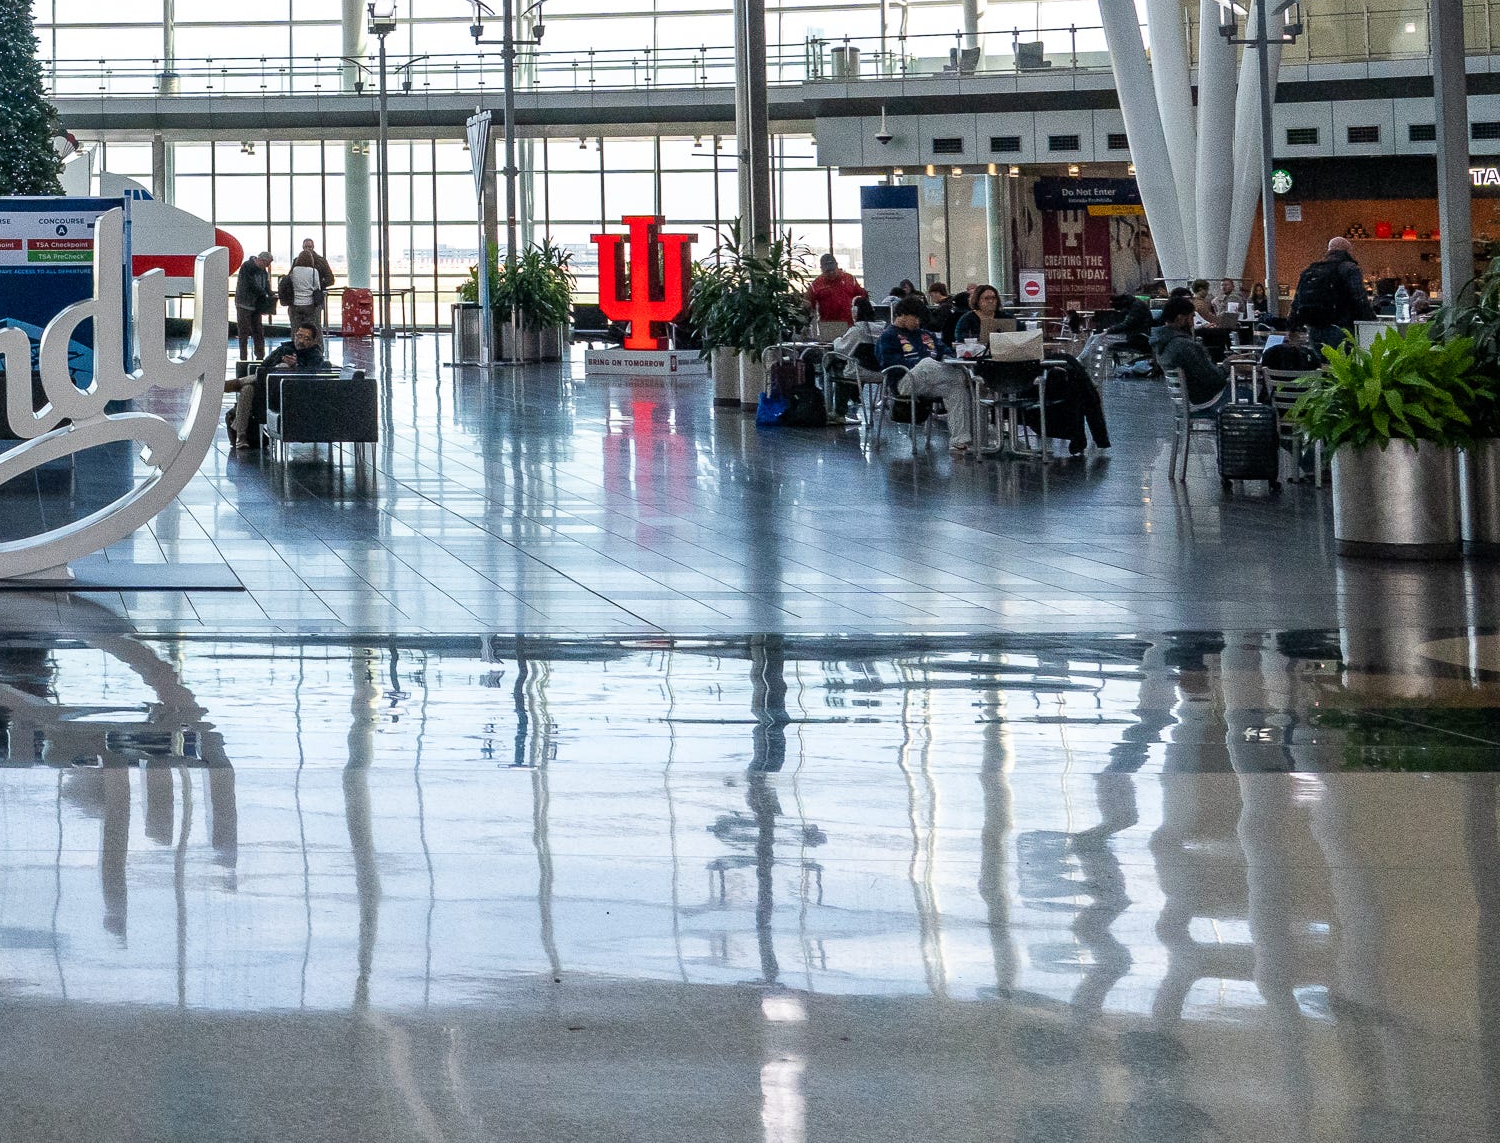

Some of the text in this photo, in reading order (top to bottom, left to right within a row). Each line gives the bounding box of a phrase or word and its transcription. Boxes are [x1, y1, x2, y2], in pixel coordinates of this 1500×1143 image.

[1075, 189, 1092, 197] Not
[1094, 188, 1116, 197] Enter
[50, 241, 88, 249] Checkpoint
[1044, 256, 1103, 267] CREATING THE
[624, 360, 665, 368] TOMORROW
